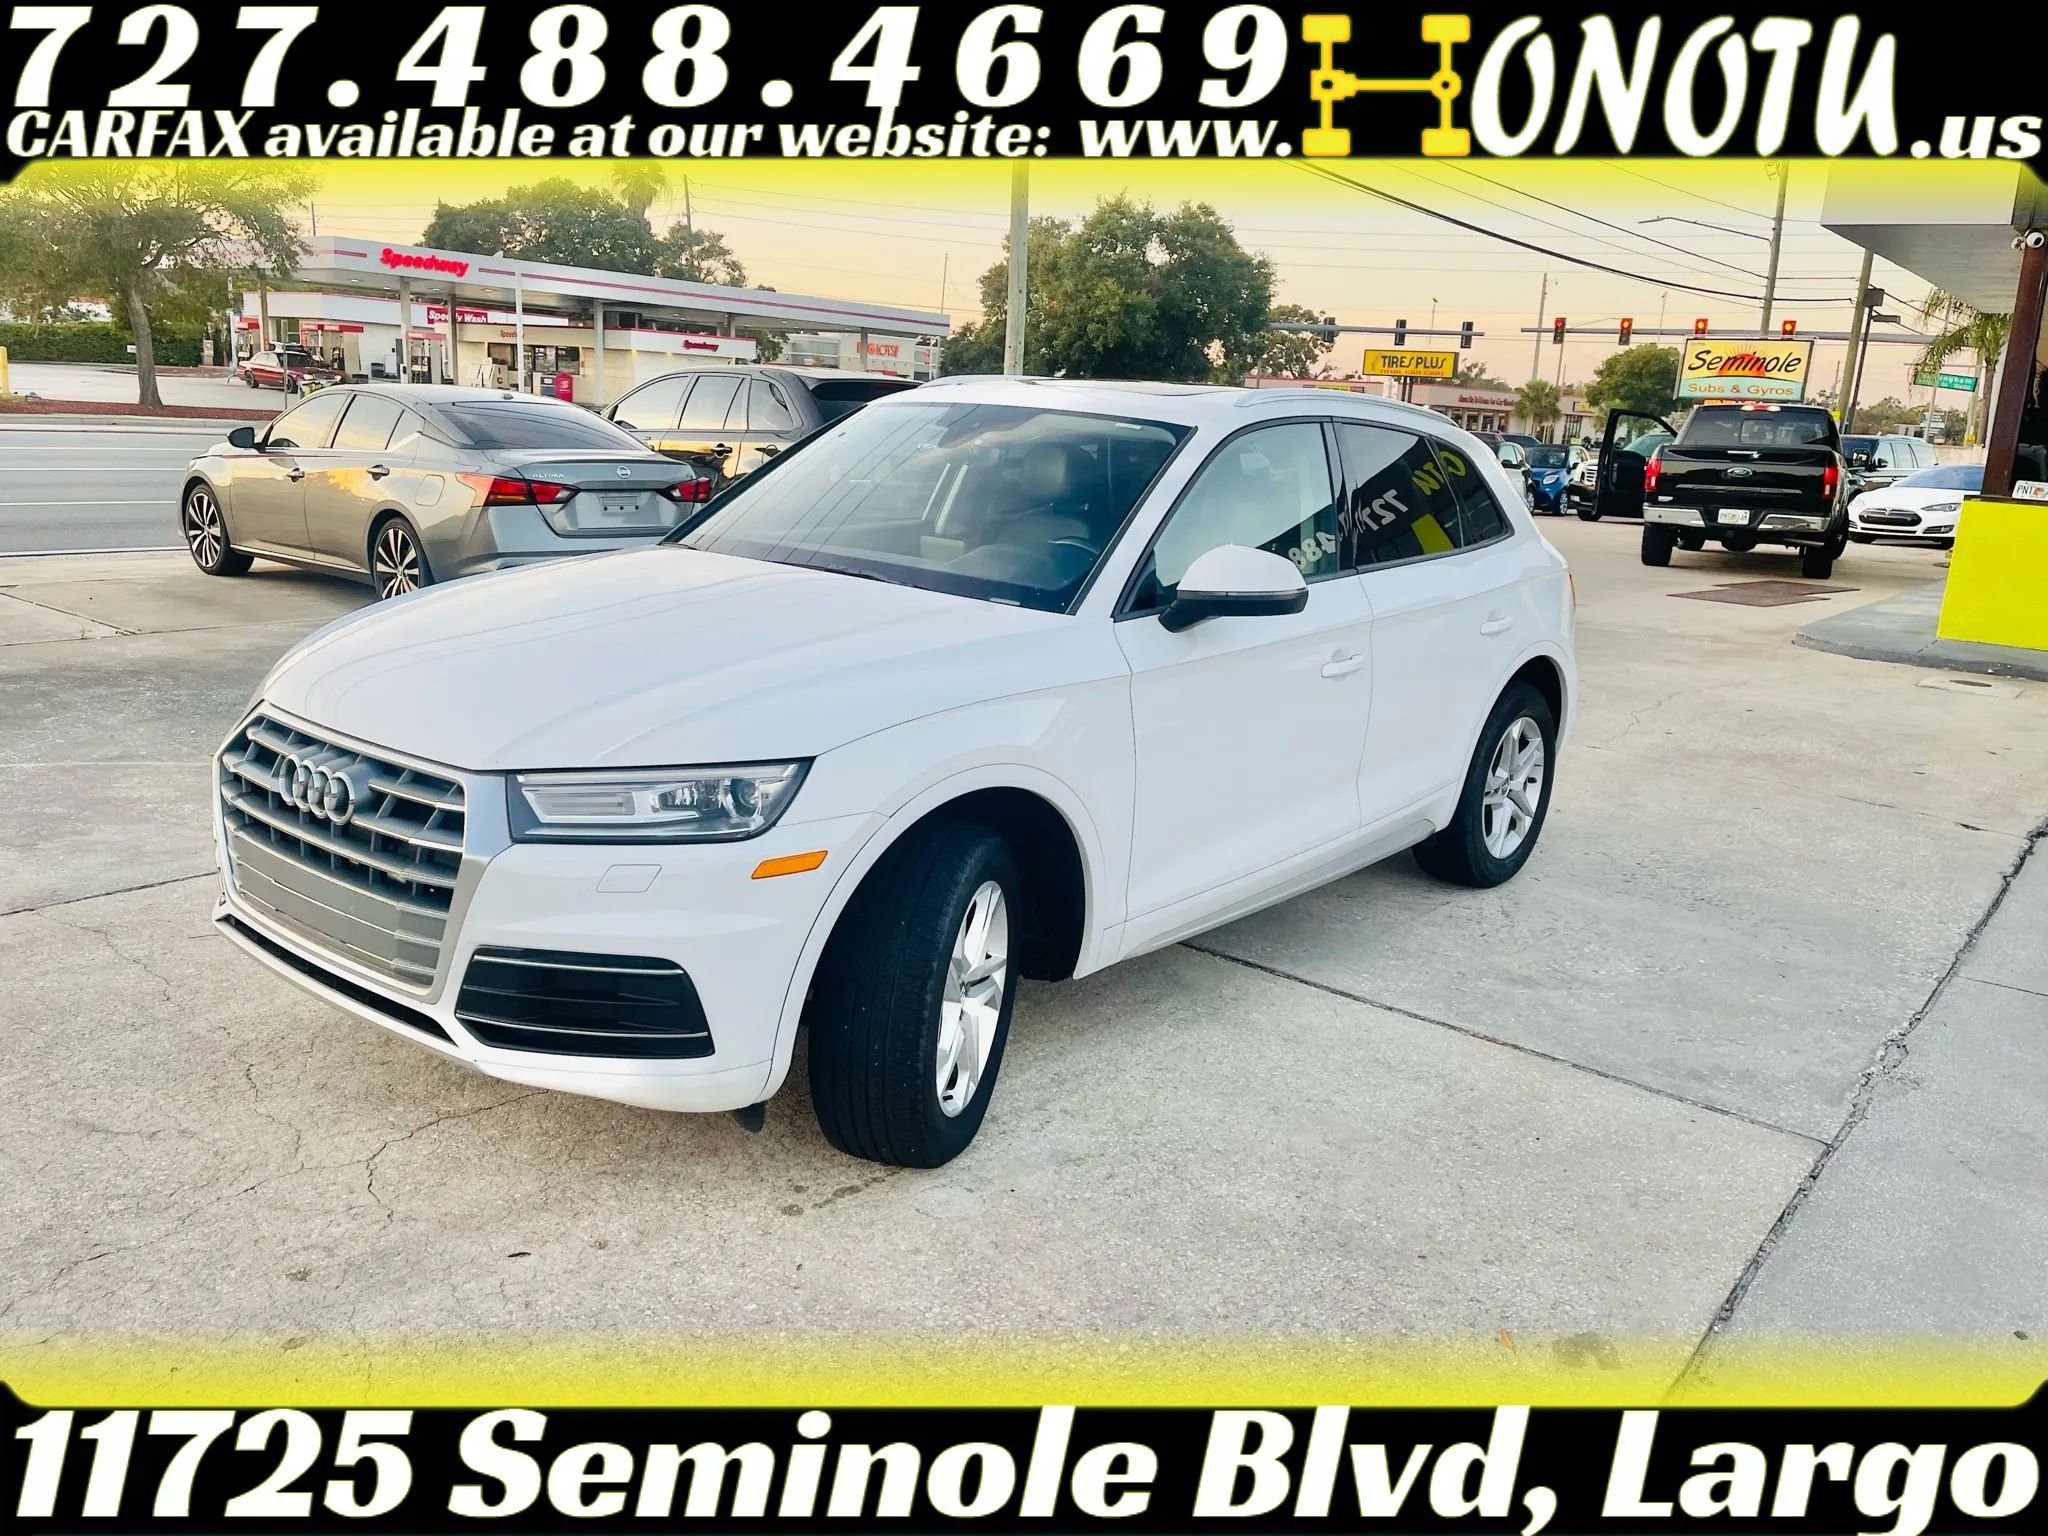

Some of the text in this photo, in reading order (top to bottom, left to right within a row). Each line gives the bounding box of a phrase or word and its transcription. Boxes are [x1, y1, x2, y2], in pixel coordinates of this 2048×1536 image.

[380, 248, 469, 277] Speedway
[464, 313, 487, 323] Wash
[1381, 355, 1446, 369] TIRES PLUS
[1688, 349, 1801, 373] Seminole
[1688, 383, 1794, 396] Subs & Gyros
